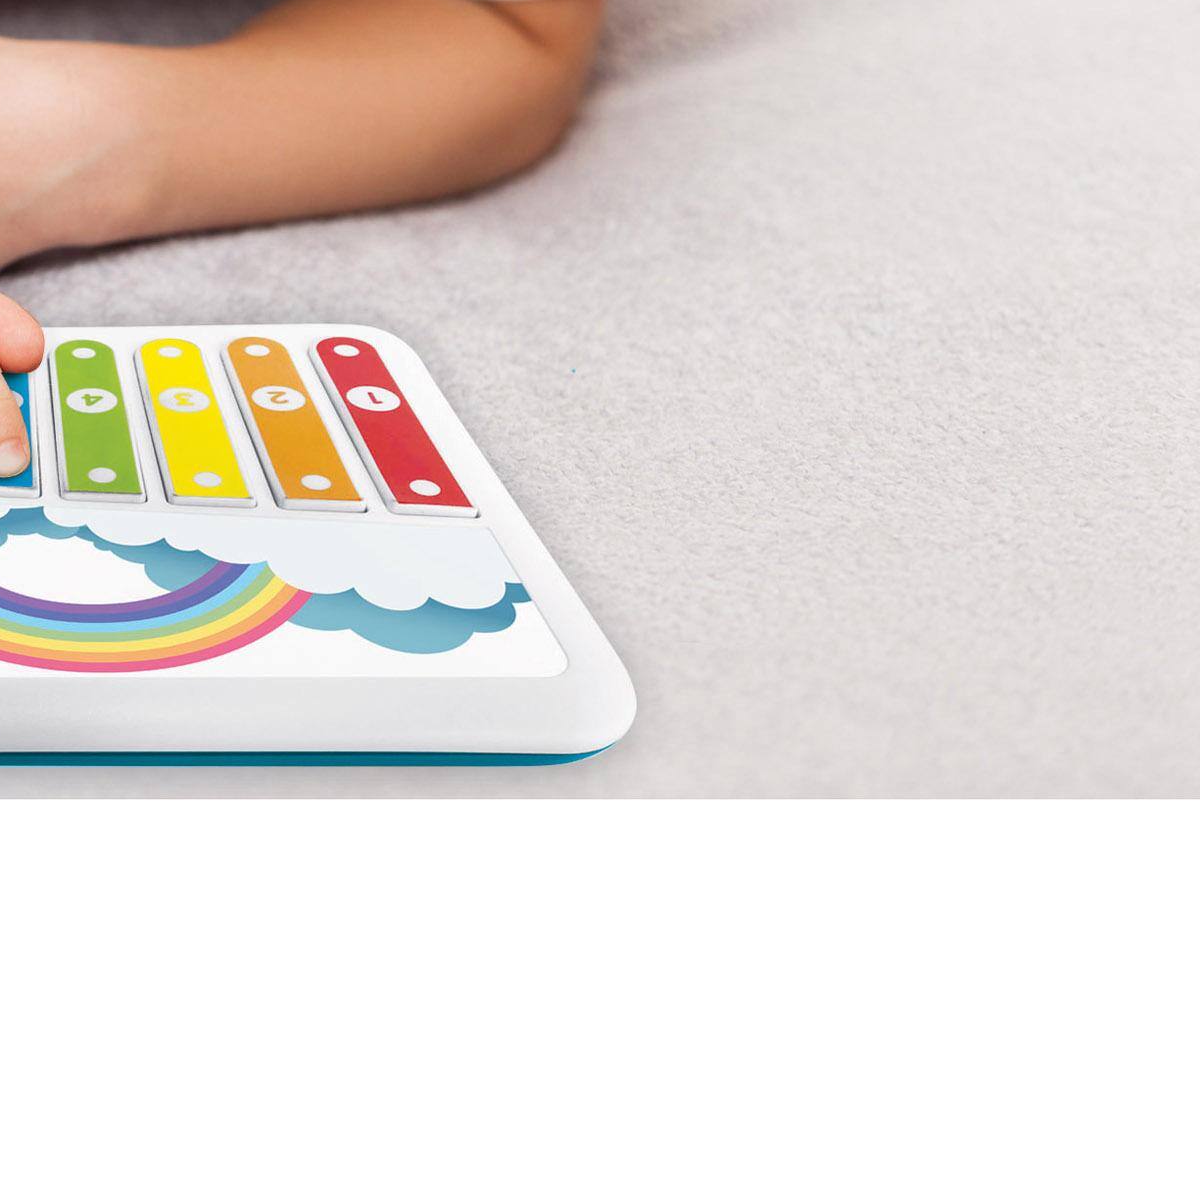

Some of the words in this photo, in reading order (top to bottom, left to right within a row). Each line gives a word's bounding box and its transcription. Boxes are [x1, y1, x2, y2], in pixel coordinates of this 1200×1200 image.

[81, 393, 104, 406] 4
[173, 392, 195, 406] 3
[266, 391, 289, 405] 2
[367, 391, 383, 405] 1
